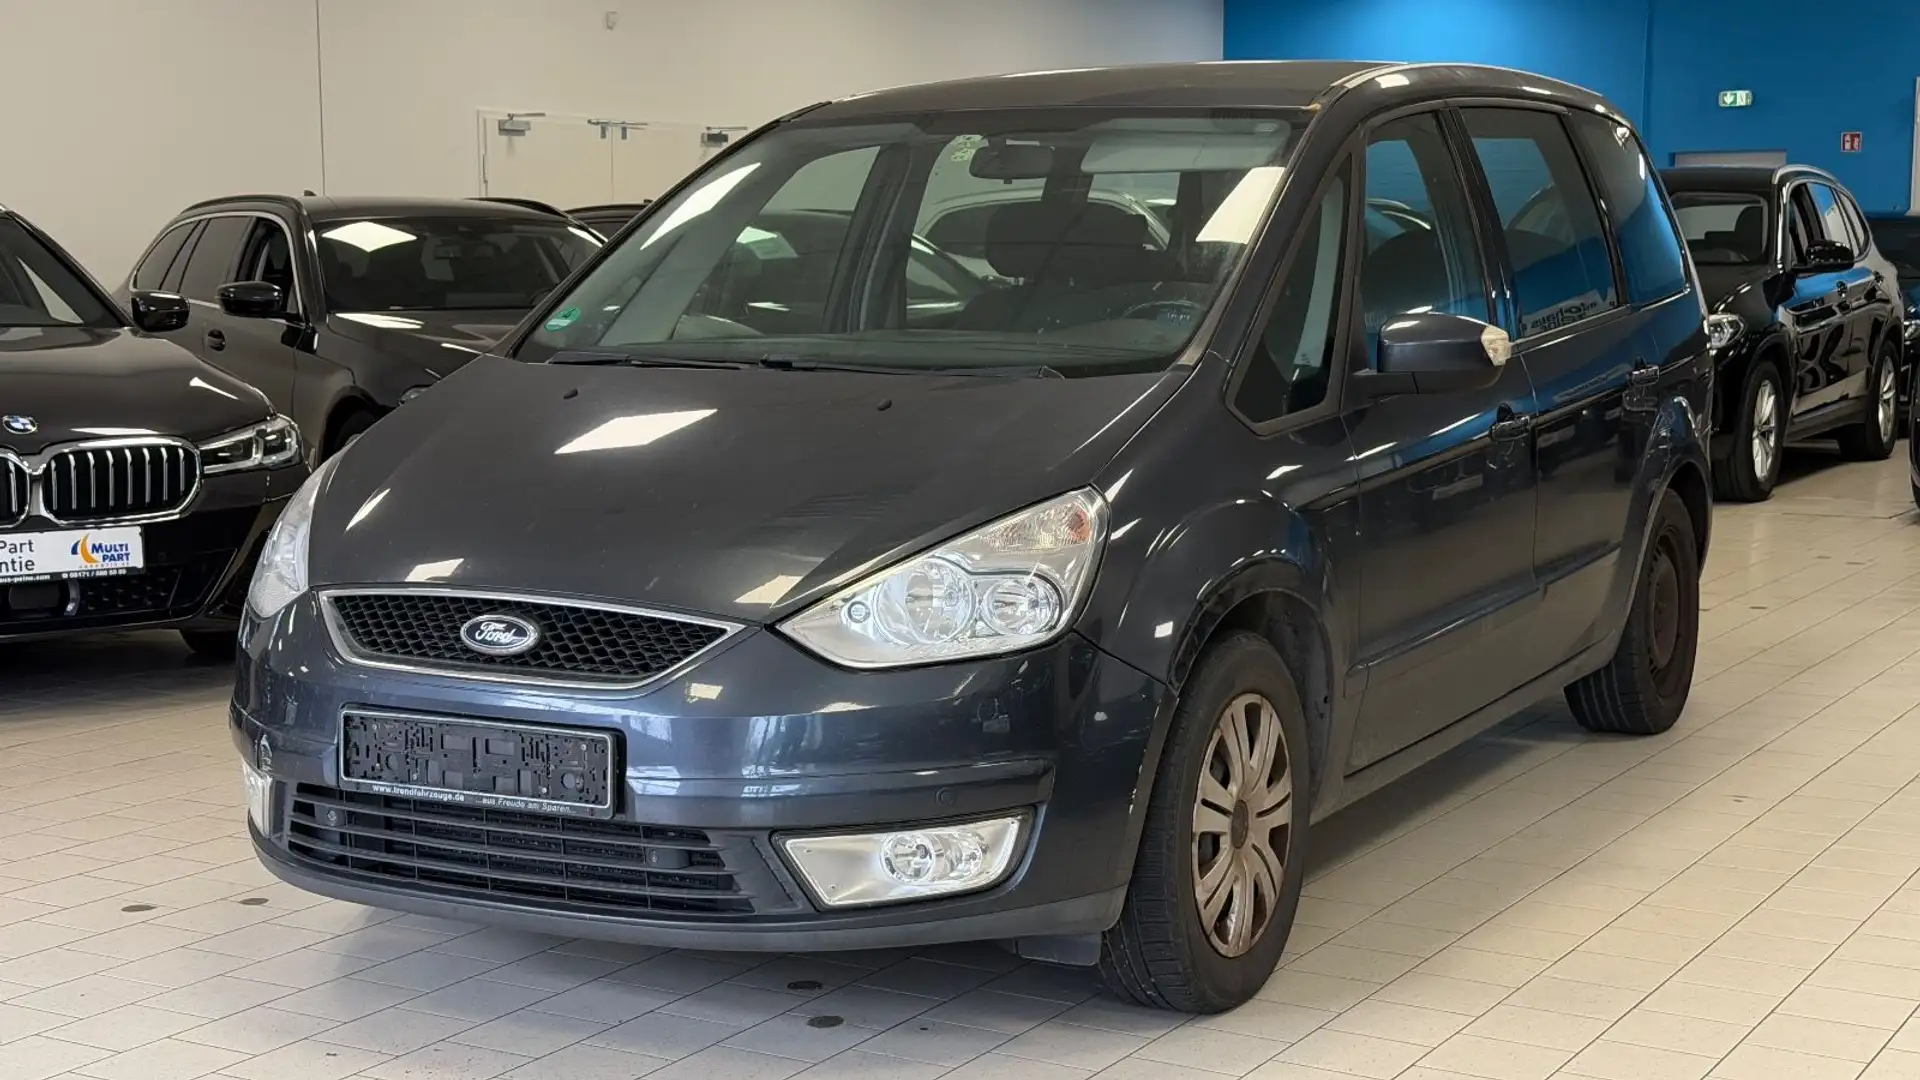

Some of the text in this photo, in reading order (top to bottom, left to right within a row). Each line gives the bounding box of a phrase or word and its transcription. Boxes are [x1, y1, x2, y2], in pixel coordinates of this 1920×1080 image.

[0, 539, 34, 554] Part
[92, 542, 129, 554] MULTI
[102, 552, 131, 562] PART
[475, 621, 525, 644] Ford
[372, 785, 465, 802] www.trendfahrzeuge.de
[498, 798, 525, 808] Freude
